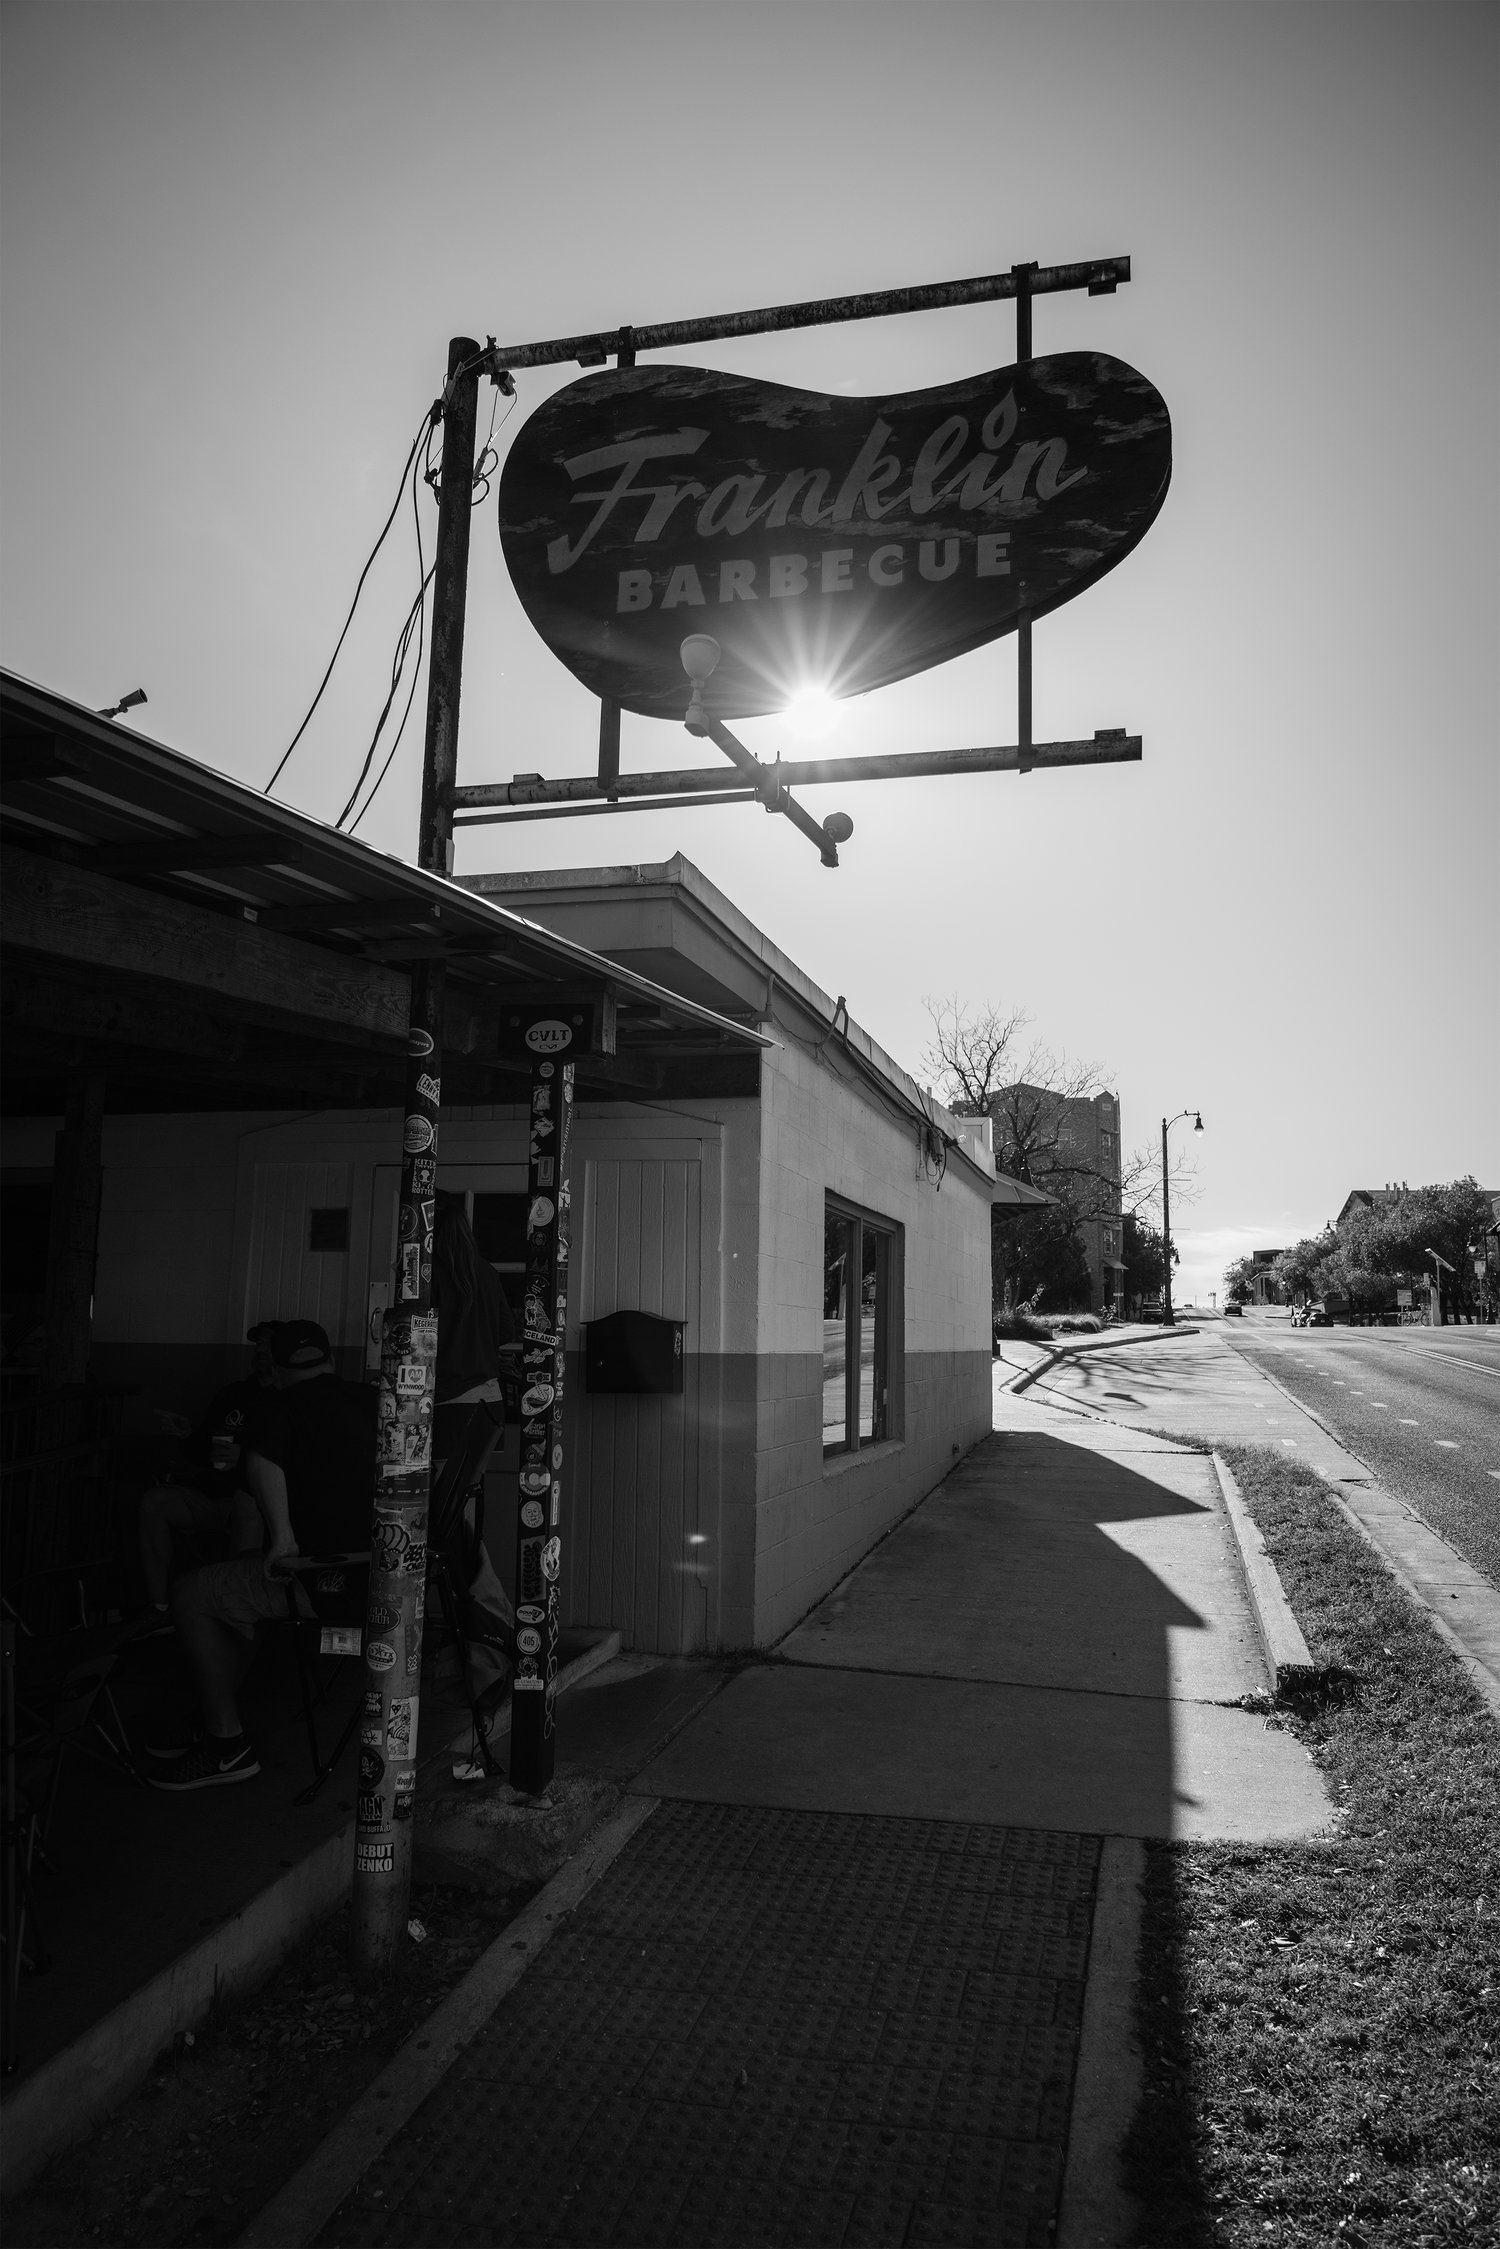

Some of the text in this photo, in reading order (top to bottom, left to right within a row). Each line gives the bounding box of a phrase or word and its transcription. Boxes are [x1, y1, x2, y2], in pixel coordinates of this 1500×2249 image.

[547, 388, 1088, 574] Franklin
[616, 532, 1011, 614] BARBECUE
[528, 1029, 569, 1042] CVLT
[397, 1383, 425, 1391] WYNWOOD
[357, 1843, 393, 1858] DEBUT
[357, 1857, 393, 1873] ZENKO
